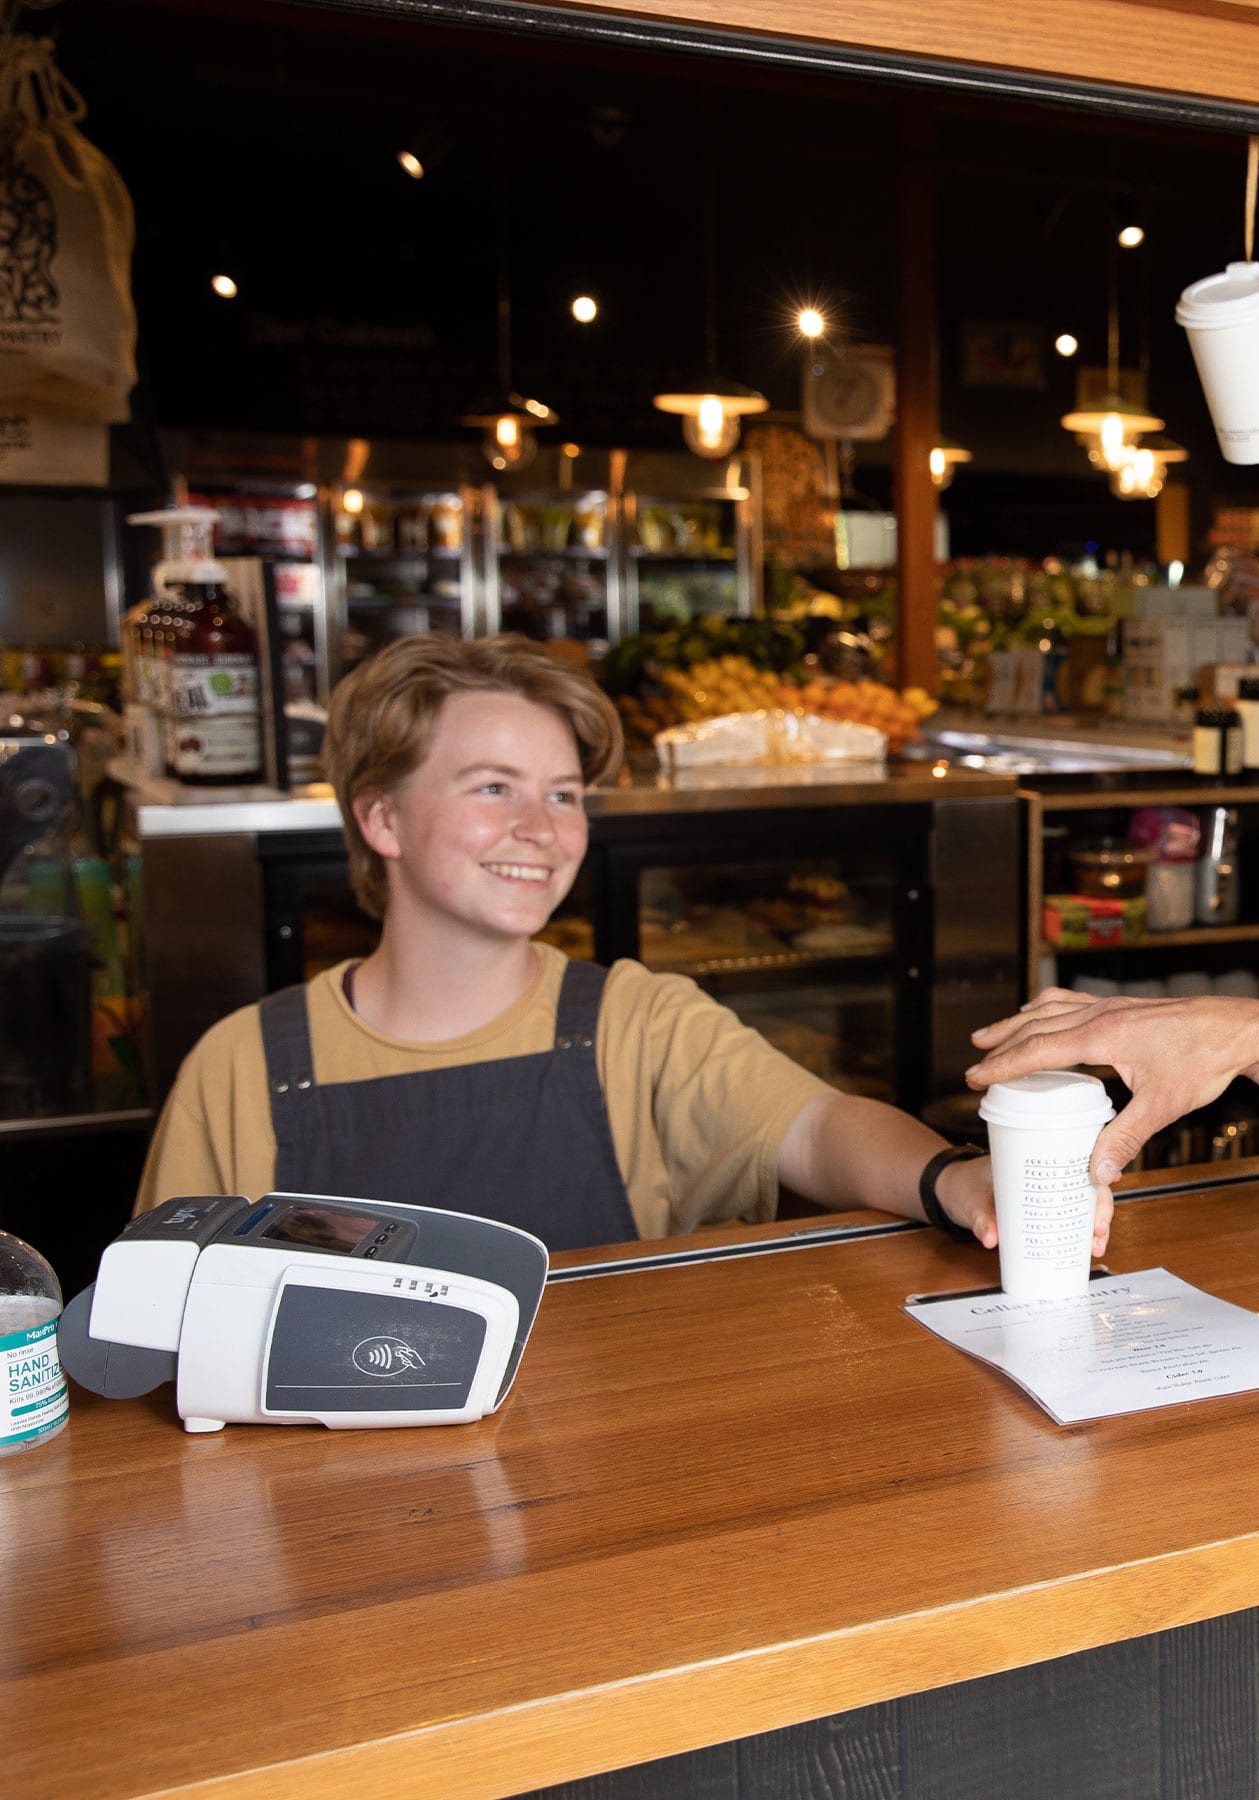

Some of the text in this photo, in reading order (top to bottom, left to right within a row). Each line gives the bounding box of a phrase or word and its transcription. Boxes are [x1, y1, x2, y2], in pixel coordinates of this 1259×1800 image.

[970, 1302, 1030, 1316] Cellar
[9, 1353, 50, 1378] HAND
[9, 1396, 25, 1406] Kills
